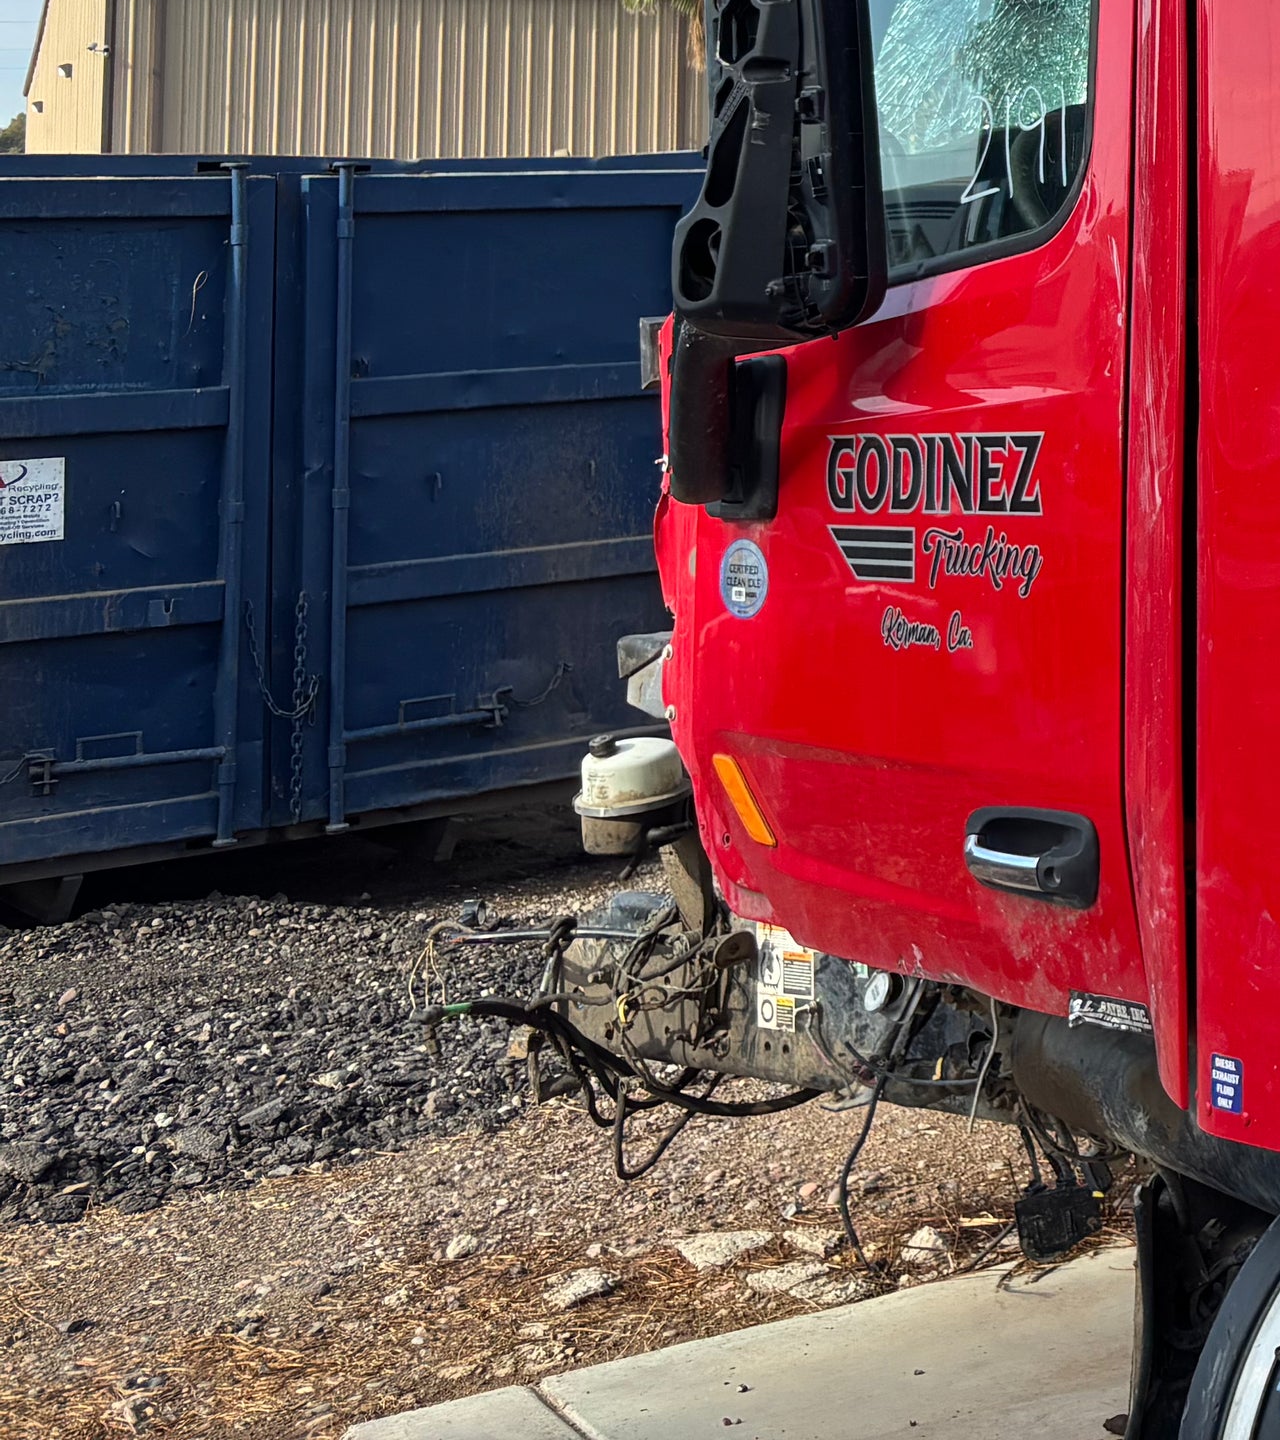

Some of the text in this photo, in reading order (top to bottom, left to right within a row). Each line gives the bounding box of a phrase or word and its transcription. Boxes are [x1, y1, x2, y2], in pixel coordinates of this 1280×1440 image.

[960, 84, 1067, 205] 2191
[826, 431, 1046, 516] GODINEZ
[9, 492, 59, 506] SCRAP?
[729, 563, 759, 575] CERTIFIED
[922, 525, 1044, 599] Trucking
[726, 576, 761, 589] CLEAN IDLE
[881, 605, 974, 653] Kerman, Ca.
[1214, 1057, 1236, 1071] DIESEL
[1212, 1068, 1240, 1085] EXHAUST
[1216, 1083, 1235, 1097] FLUID
[1217, 1096, 1233, 1109] ONLY
